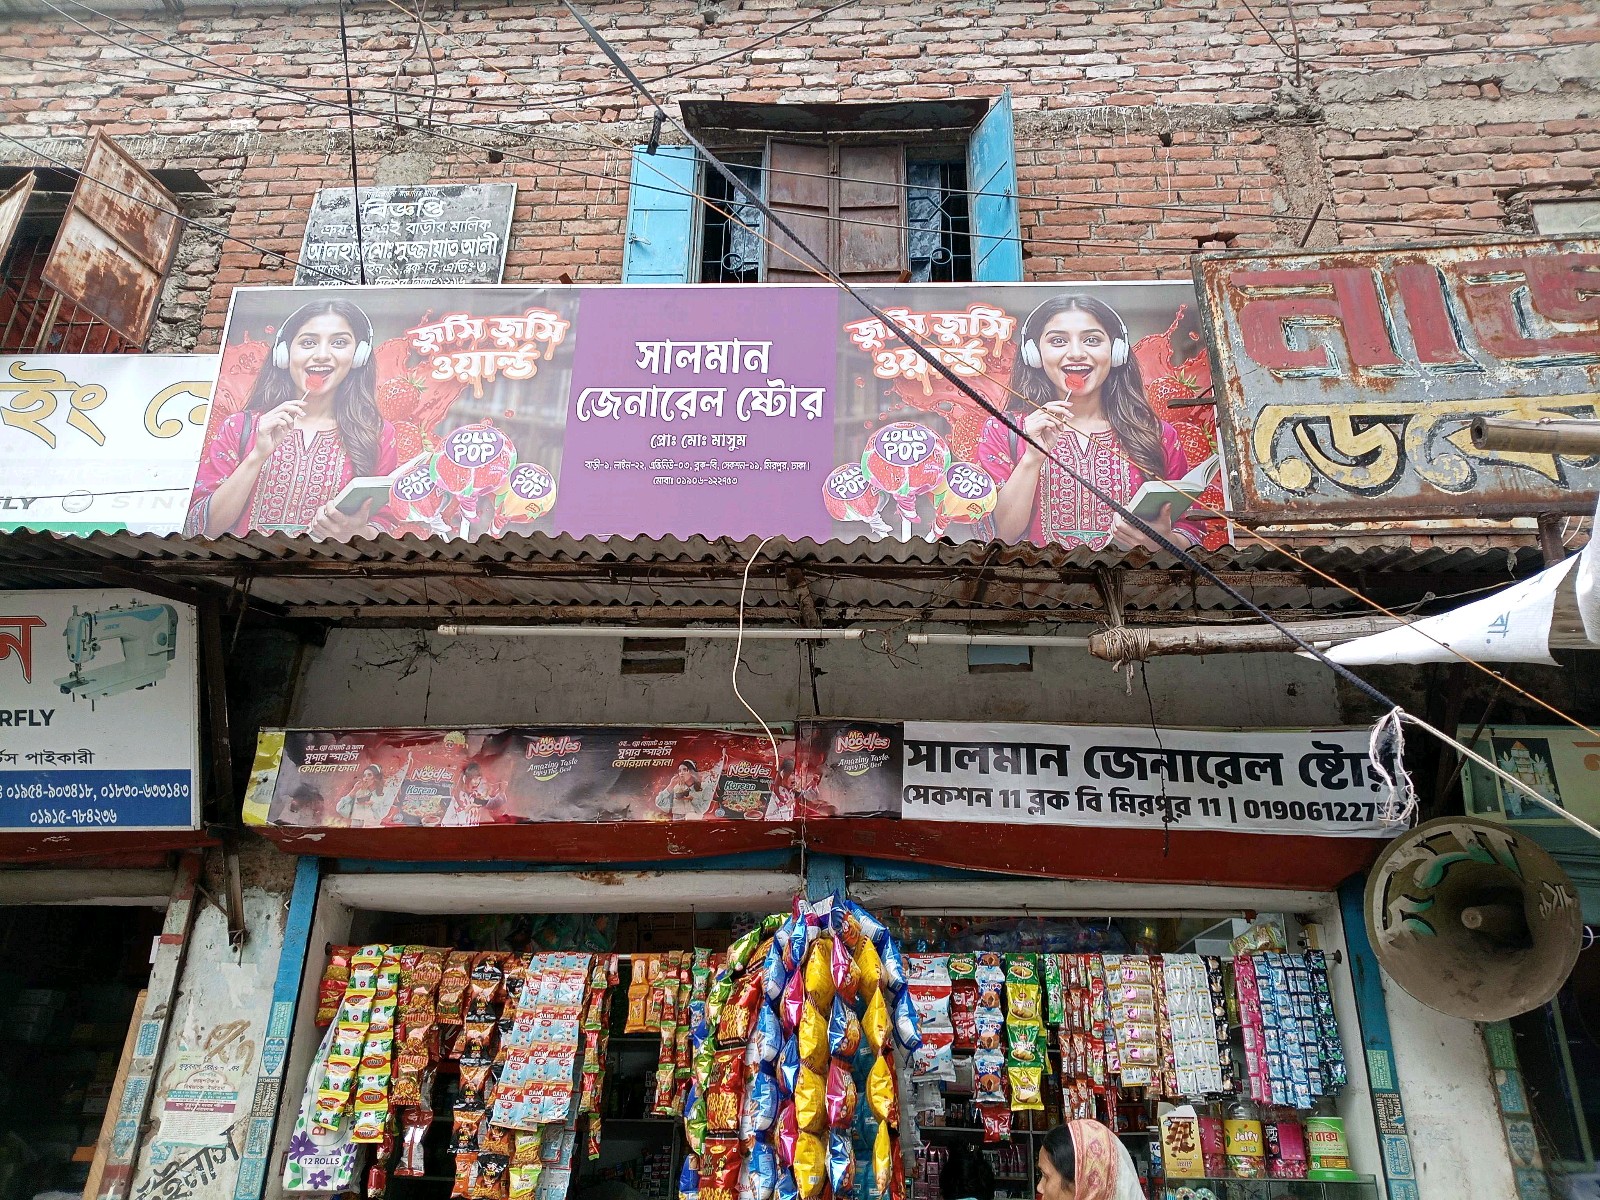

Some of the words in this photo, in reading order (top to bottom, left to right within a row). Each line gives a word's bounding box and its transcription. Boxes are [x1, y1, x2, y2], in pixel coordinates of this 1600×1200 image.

[450, 216, 492, 233] মালিক
[461, 232, 499, 257] আলী
[635, 337, 773, 374] সালমান
[576, 385, 728, 422] জেনারেল
[736, 378, 827, 422] ষ্টোর
[452, 431, 498, 444] LOLLI
[681, 433, 707, 449] মোঃ
[711, 432, 748, 452] মাসুম
[881, 429, 928, 442] LOLLI
[453, 444, 497, 463] POP
[883, 441, 927, 462] POP
[401, 475, 436, 500] POP
[512, 475, 543, 498] POP
[835, 475, 870, 499] POP
[949, 474, 983, 498] POP
[0, 496, 39, 510] LY
[527, 737, 581, 758] Noodles
[836, 733, 889, 752] Noodles
[25, 748, 95, 765] পাইকারী
[904, 739, 1070, 777] সালমান
[1084, 745, 1284, 789] জেনারেল
[411, 767, 454, 782] Noodles
[728, 764, 771, 778] Noodles
[405, 785, 438, 795] Korean
[724, 781, 757, 791] Korean
[903, 785, 993, 808] সেকশন
[999, 790, 1021, 808] 11
[1026, 789, 1070, 816] ব্লক
[1075, 785, 1103, 812] বি
[1108, 787, 1191, 824] মিরপুর
[1197, 797, 1223, 817] 11
[303, 1157, 313, 1165] 12
[314, 1157, 340, 1165] ROLLS
